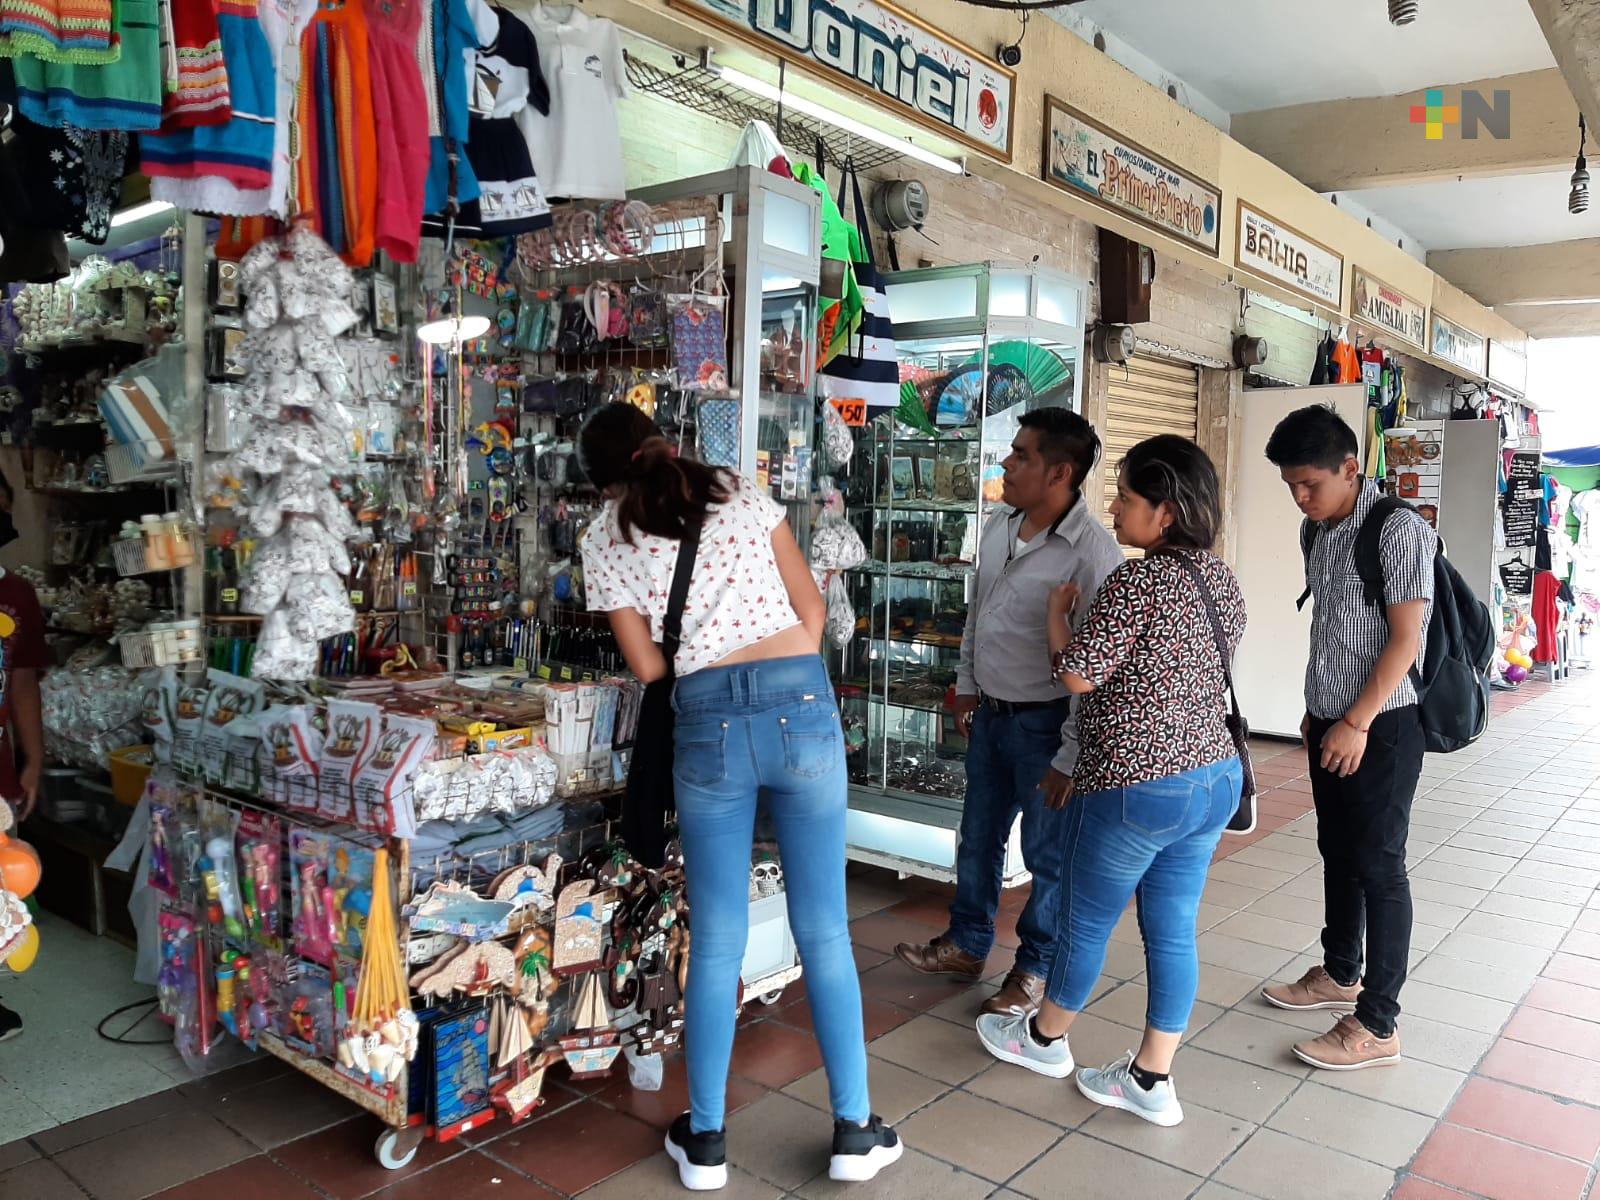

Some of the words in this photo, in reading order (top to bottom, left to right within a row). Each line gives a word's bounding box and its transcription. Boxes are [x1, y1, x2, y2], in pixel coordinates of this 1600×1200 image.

[1087, 149, 1099, 178] EL
[1098, 149, 1158, 216] Primer
[1153, 177, 1203, 236] Puerto
[1113, 146, 1158, 177] CURIOSIDADES
[1157, 169, 1167, 180] DE
[1167, 174, 1181, 188] MAR
[1245, 222, 1308, 281] BAHIA
